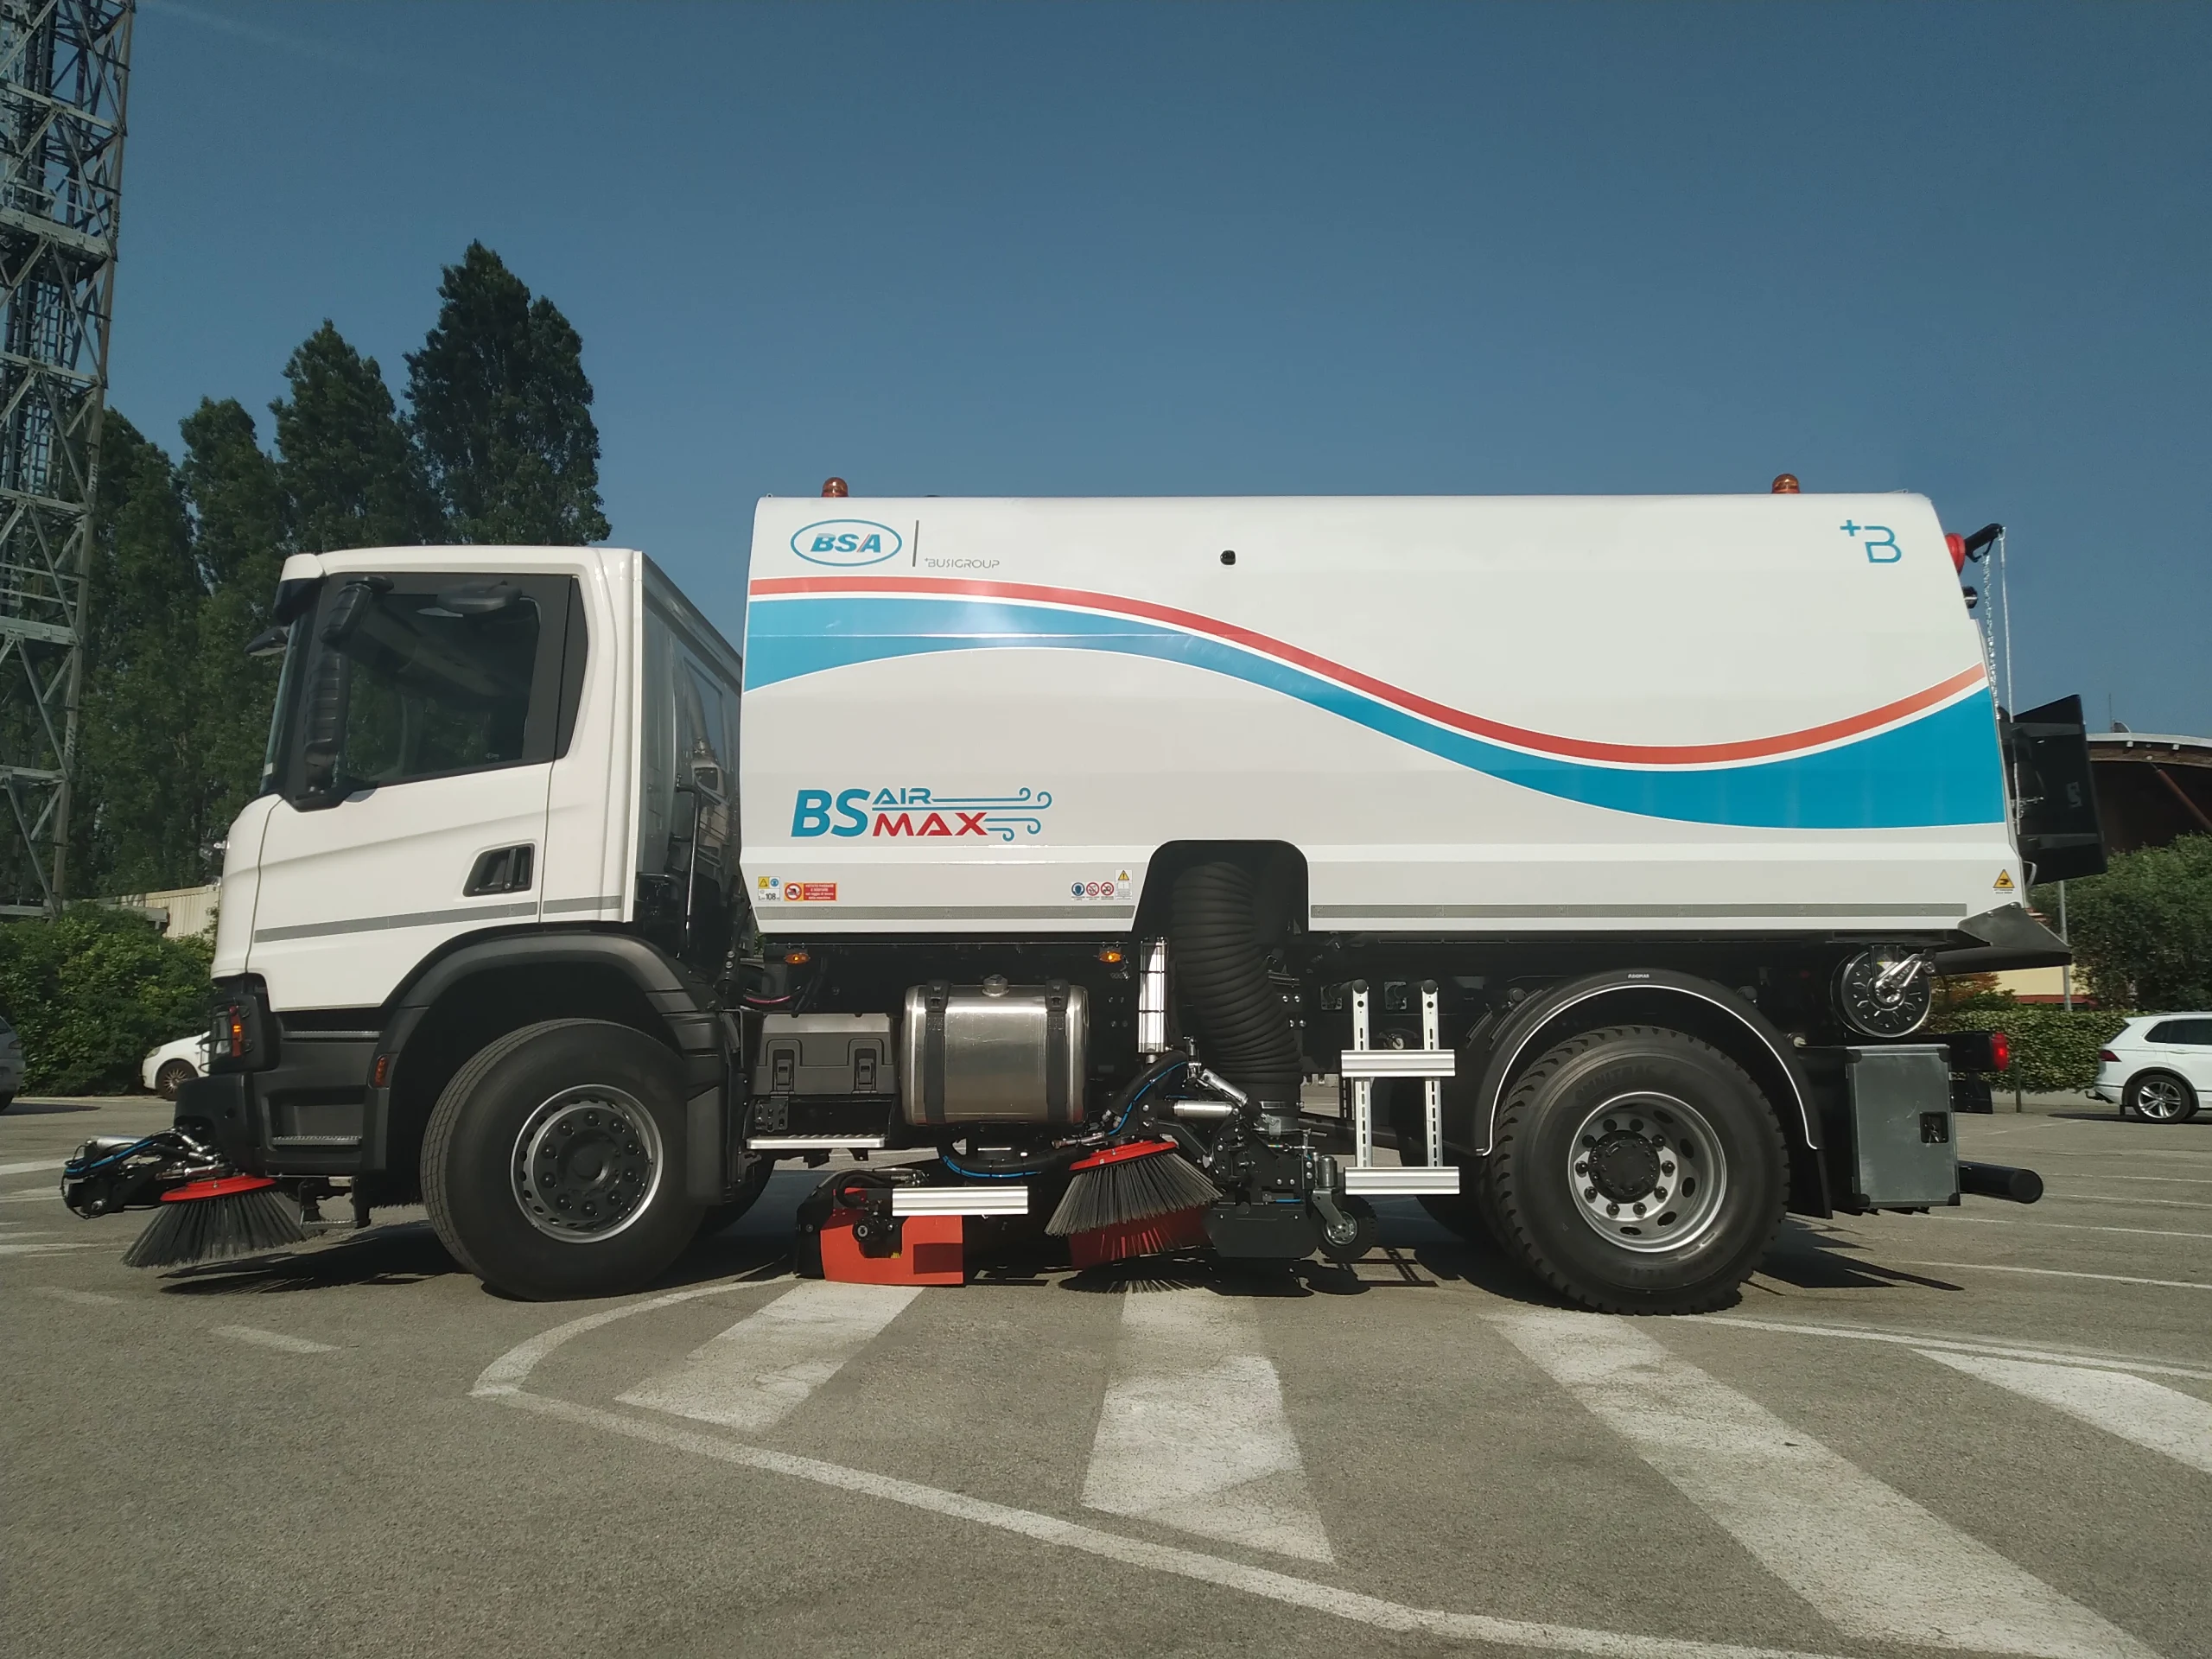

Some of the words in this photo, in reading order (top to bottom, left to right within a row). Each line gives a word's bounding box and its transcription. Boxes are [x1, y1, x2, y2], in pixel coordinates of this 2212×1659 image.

[810, 533, 881, 553] BSA
[872, 787, 932, 804] AIR
[791, 788, 871, 837] BS
[872, 812, 988, 836] MAX
